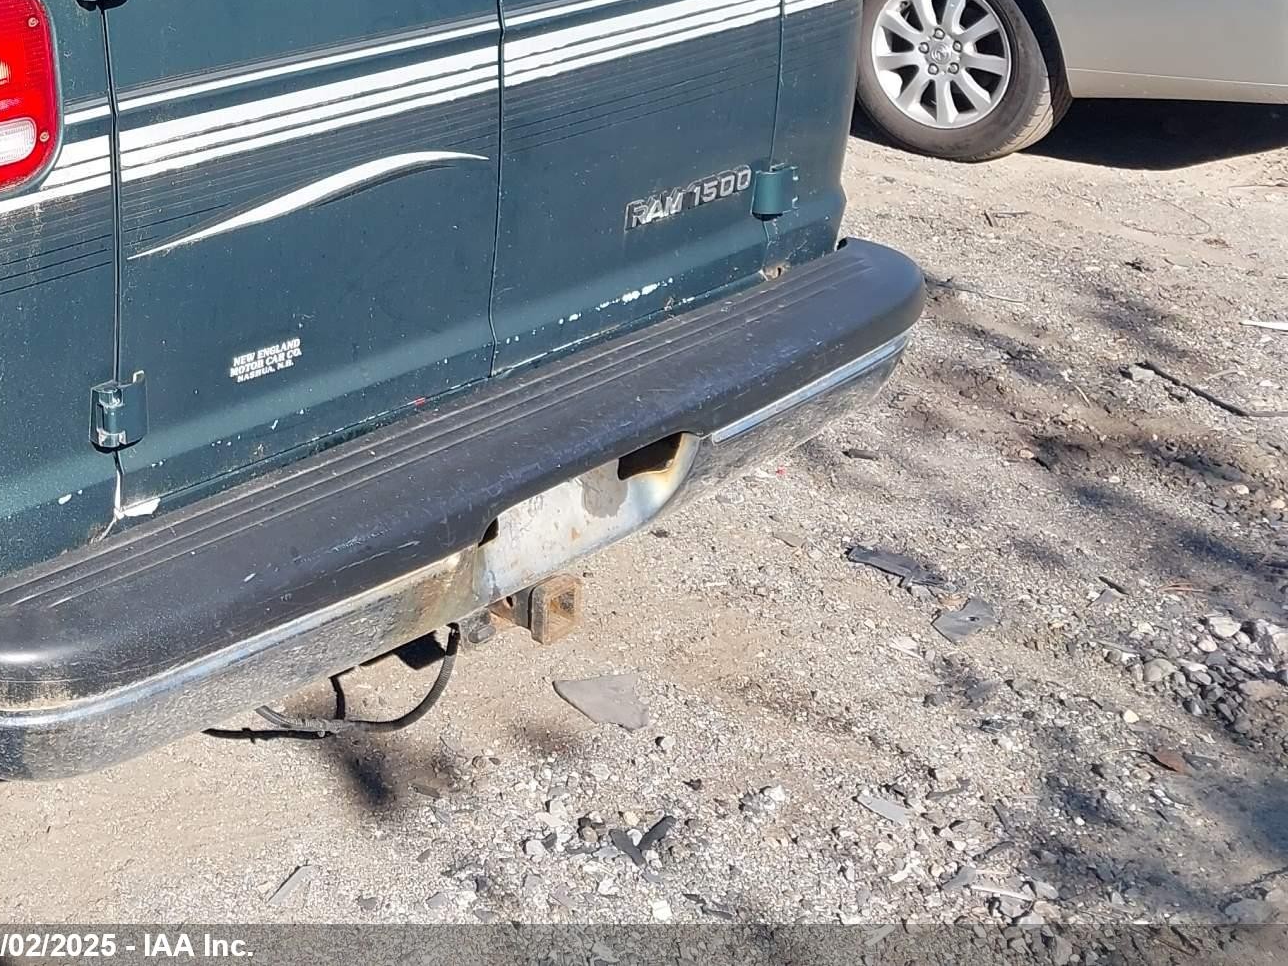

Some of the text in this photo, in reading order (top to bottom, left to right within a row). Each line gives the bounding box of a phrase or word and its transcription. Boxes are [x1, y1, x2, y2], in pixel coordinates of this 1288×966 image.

[625, 164, 752, 232] RAM 1500
[229, 347, 303, 378] MOTOR CAR CO.
[233, 338, 301, 367] NEW ENGLAND
